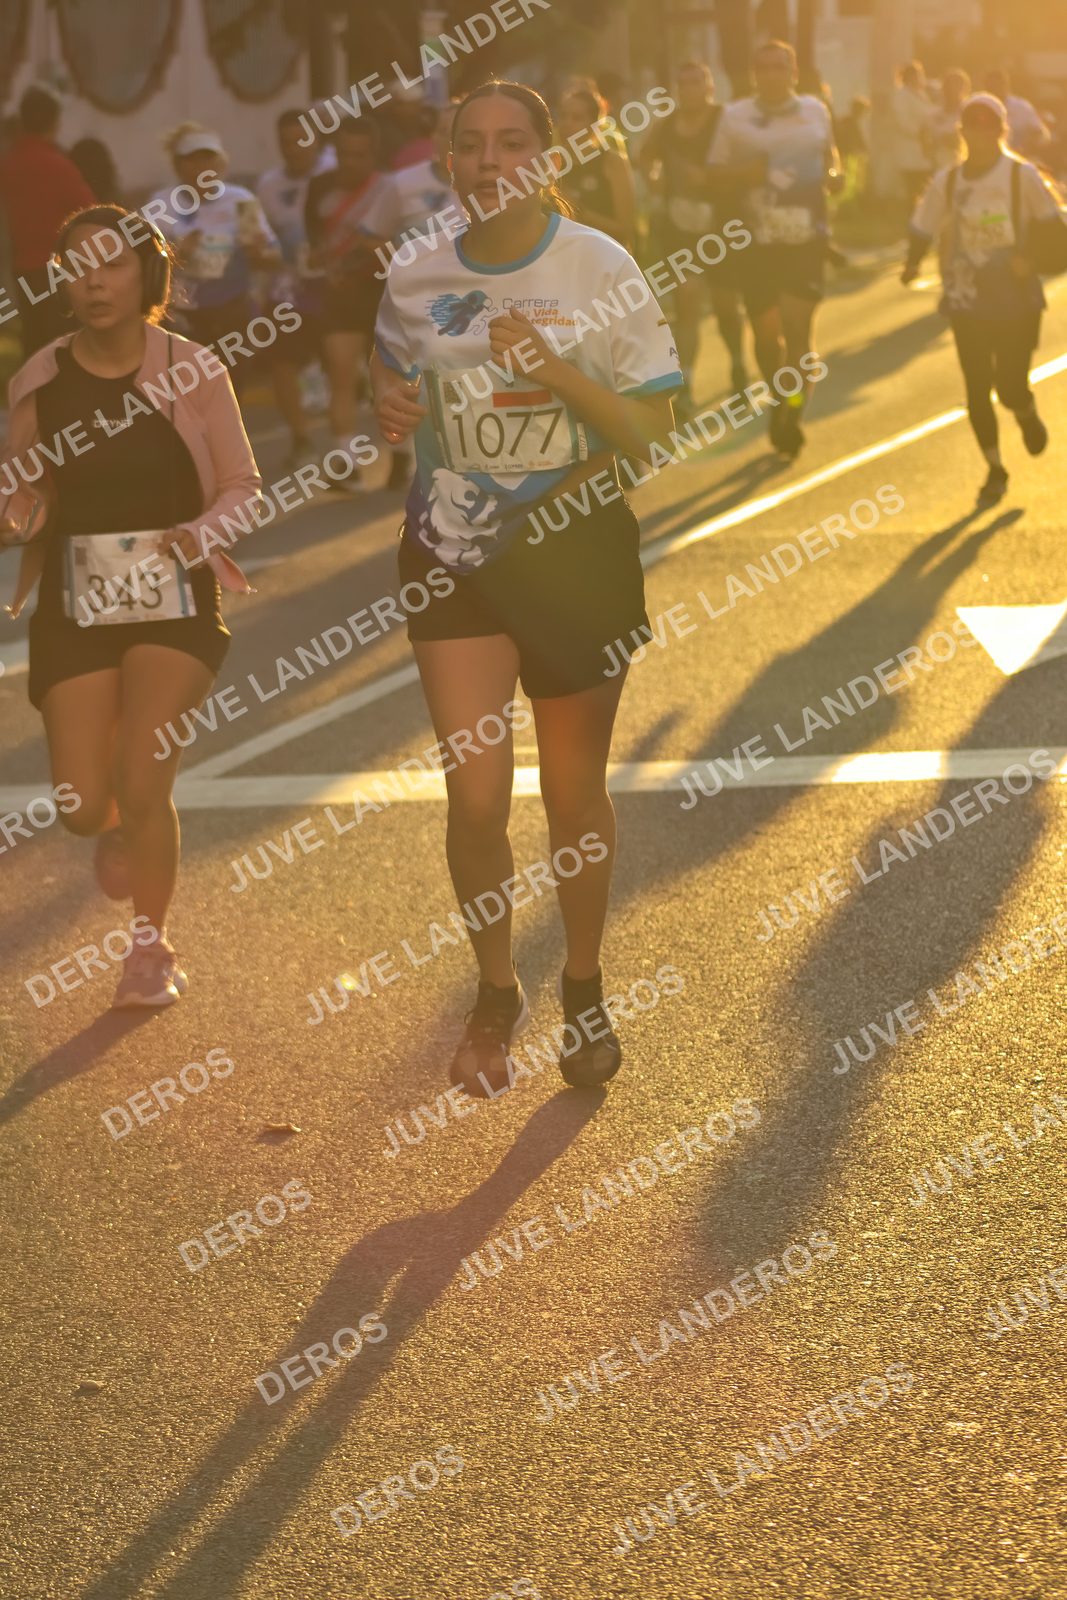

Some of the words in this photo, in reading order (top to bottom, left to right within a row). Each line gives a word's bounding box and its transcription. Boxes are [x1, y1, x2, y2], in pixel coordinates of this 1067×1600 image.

[503, 298, 559, 310] Carrera
[534, 308, 560, 318] Vida
[452, 407, 564, 459] 1077
